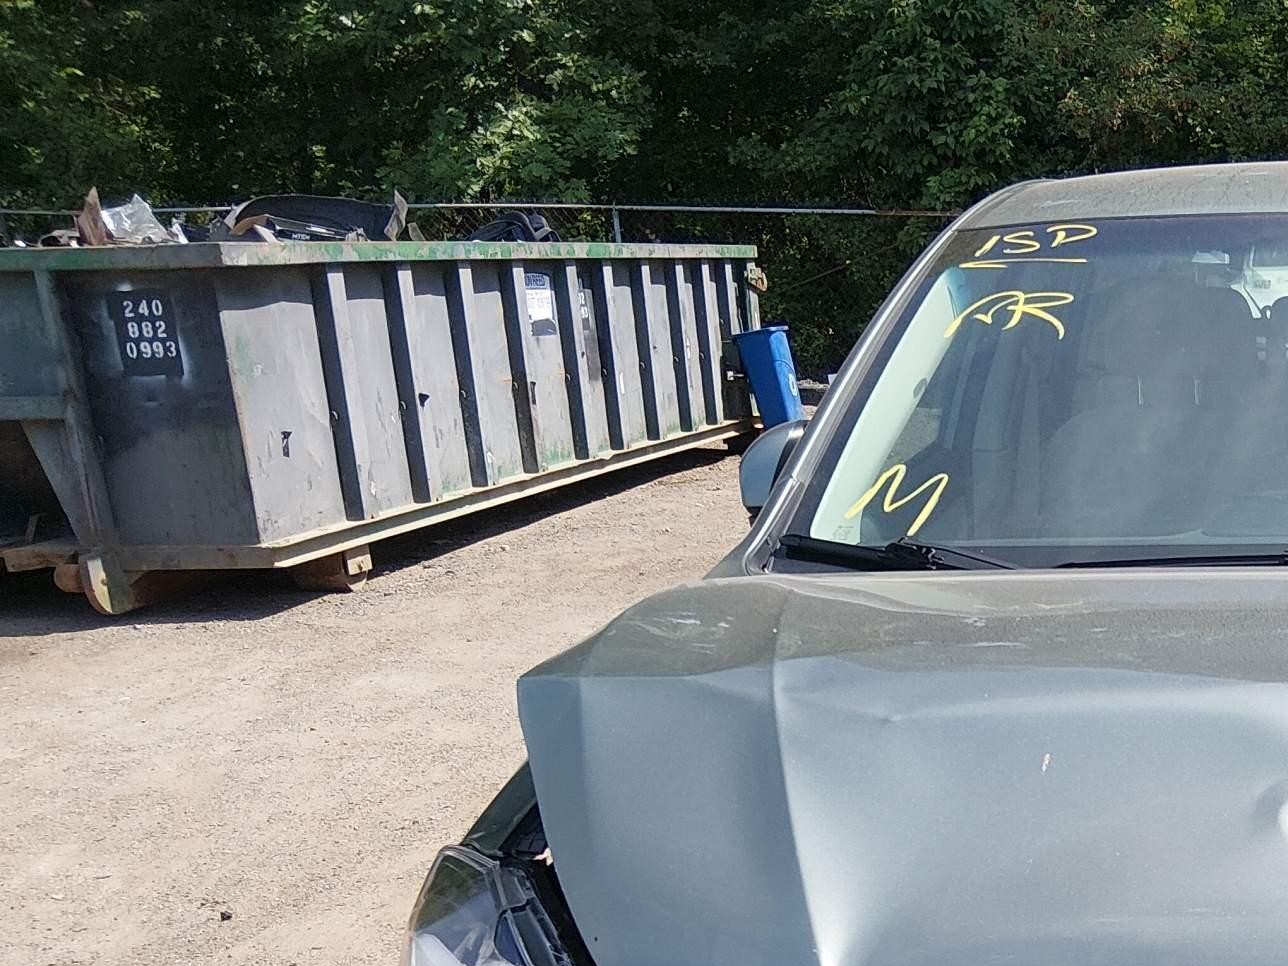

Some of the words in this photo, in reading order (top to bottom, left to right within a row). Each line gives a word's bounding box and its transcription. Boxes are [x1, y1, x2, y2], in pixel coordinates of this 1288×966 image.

[123, 299, 163, 318] 240
[127, 321, 168, 338] 882
[126, 341, 177, 359] 0993
[843, 463, 949, 537] M
